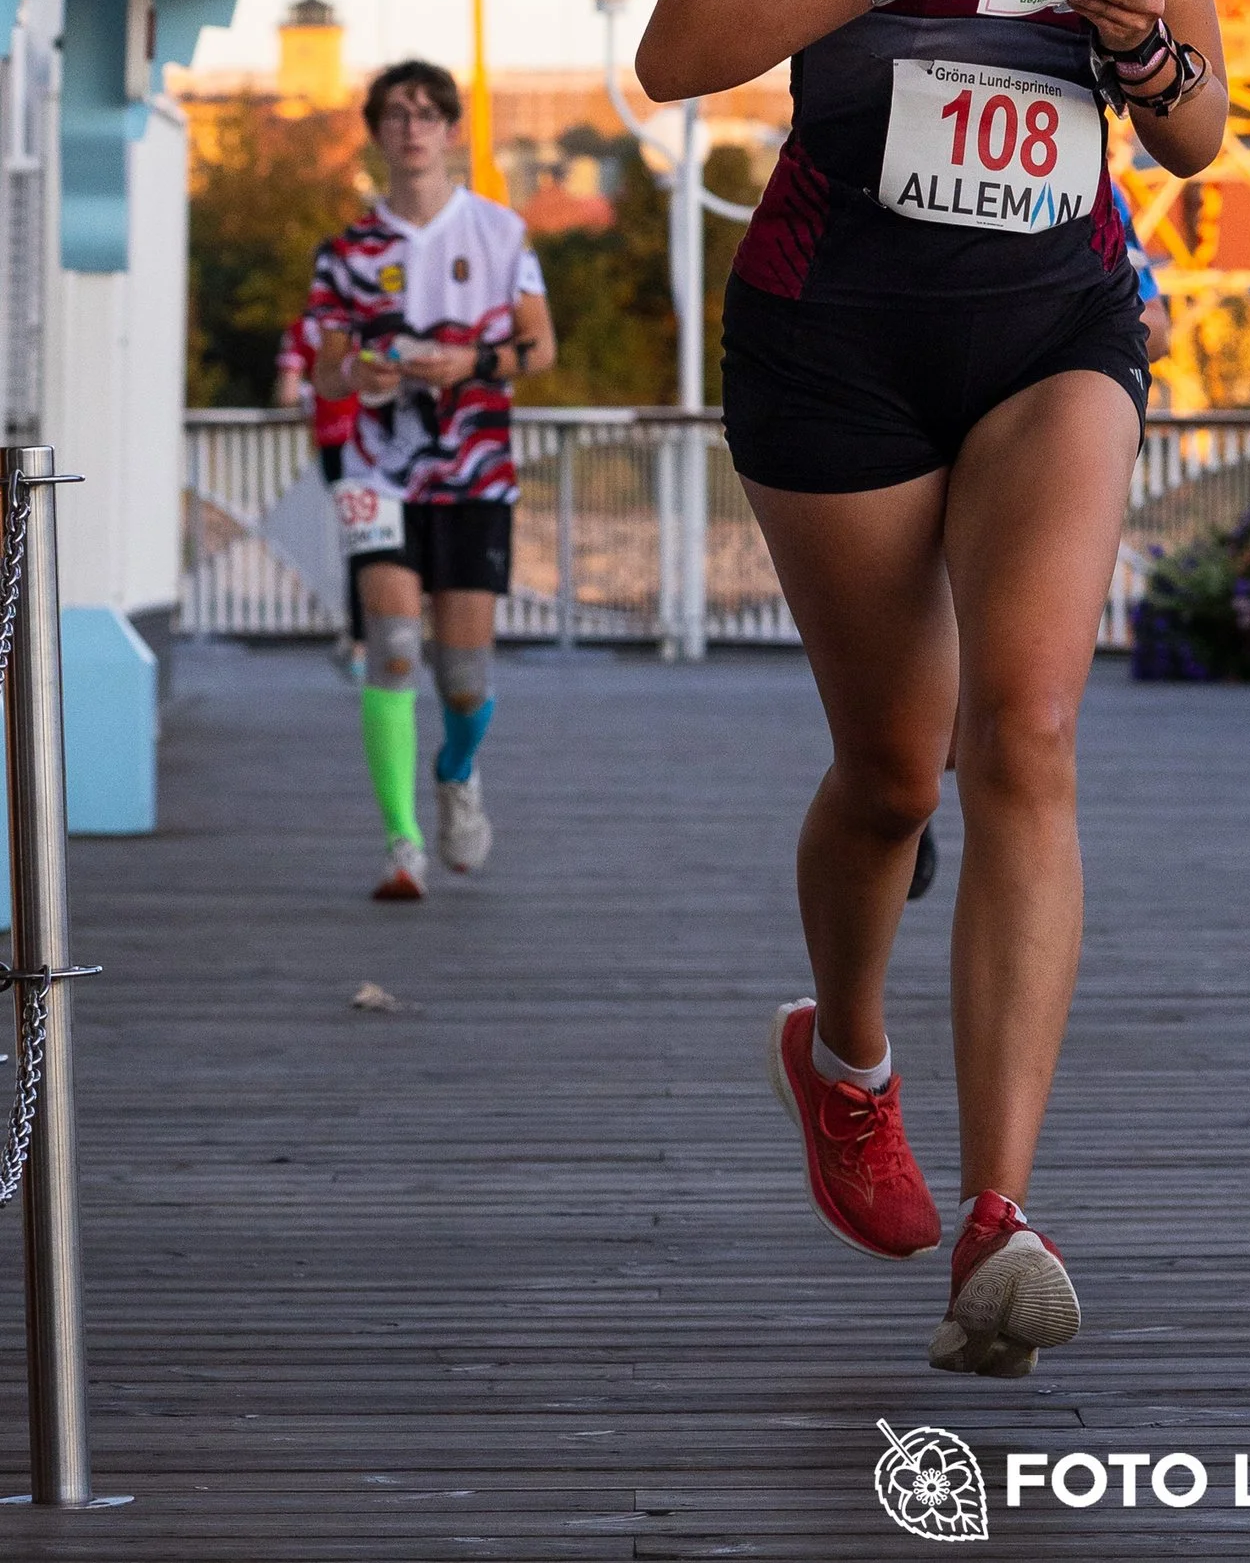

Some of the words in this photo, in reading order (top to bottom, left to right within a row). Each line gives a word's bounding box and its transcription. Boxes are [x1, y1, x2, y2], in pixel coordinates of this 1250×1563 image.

[935, 67, 975, 85] Gröna
[979, 72, 1063, 97] Lund-sprinten
[941, 89, 1059, 178] 108
[896, 171, 1083, 230] ALLEMAN
